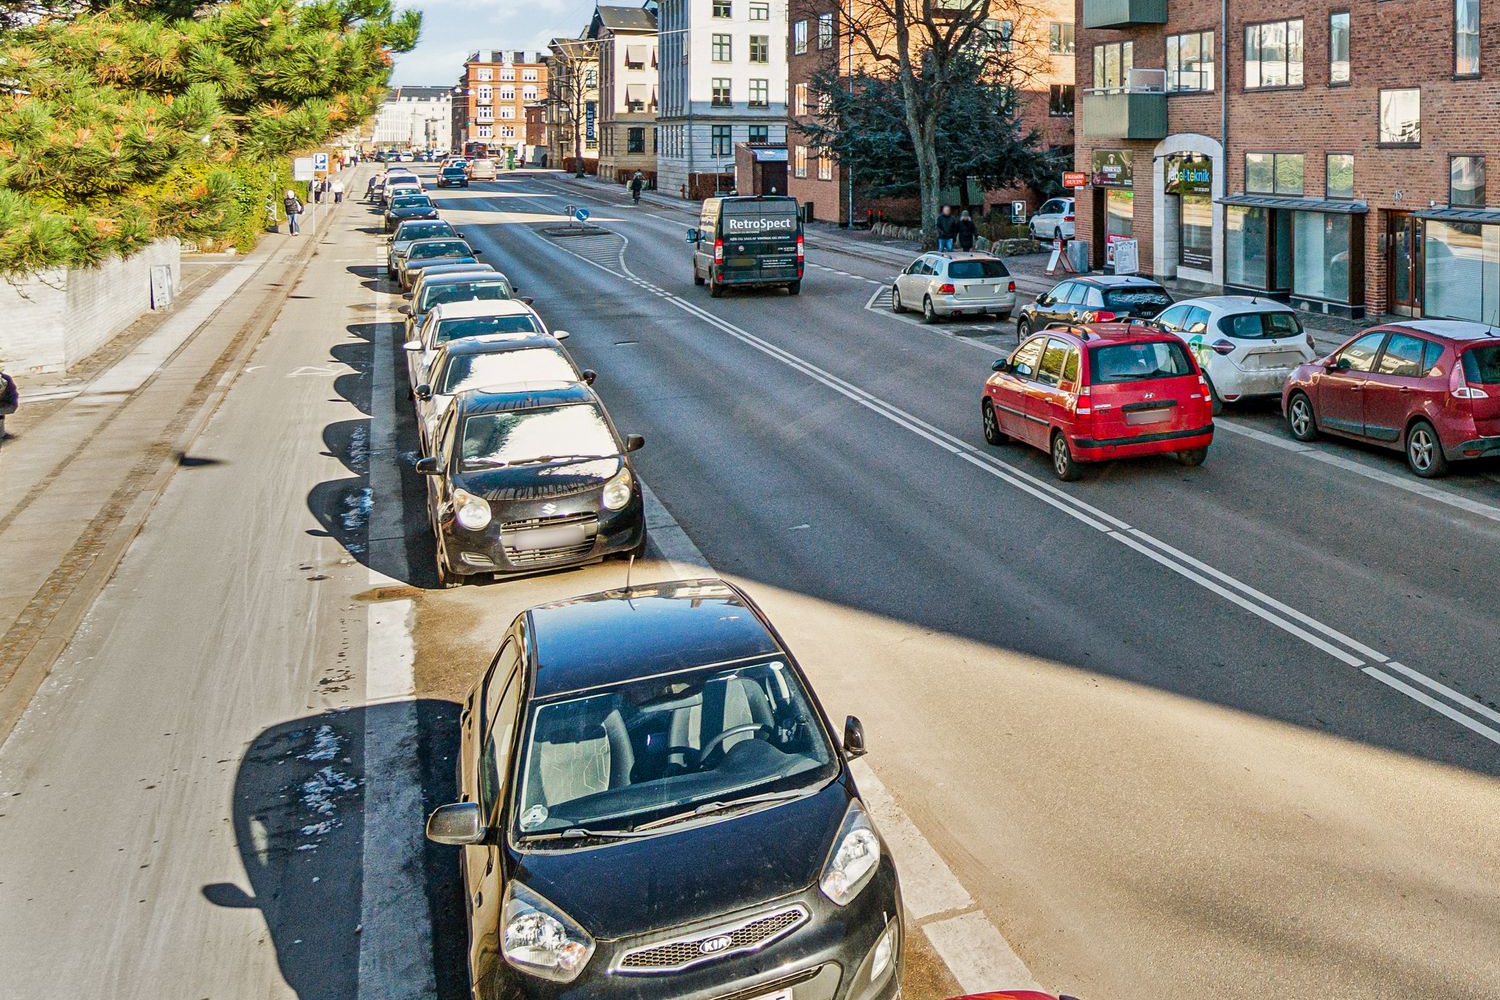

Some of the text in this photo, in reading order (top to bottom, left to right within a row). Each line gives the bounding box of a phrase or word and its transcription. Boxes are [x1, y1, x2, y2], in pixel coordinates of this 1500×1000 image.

[586, 110, 594, 137] OUTLET
[316, 154, 325, 164] P
[1015, 202, 1023, 215] P
[729, 218, 791, 230] RetroSpect
[704, 937, 729, 952] KIA
